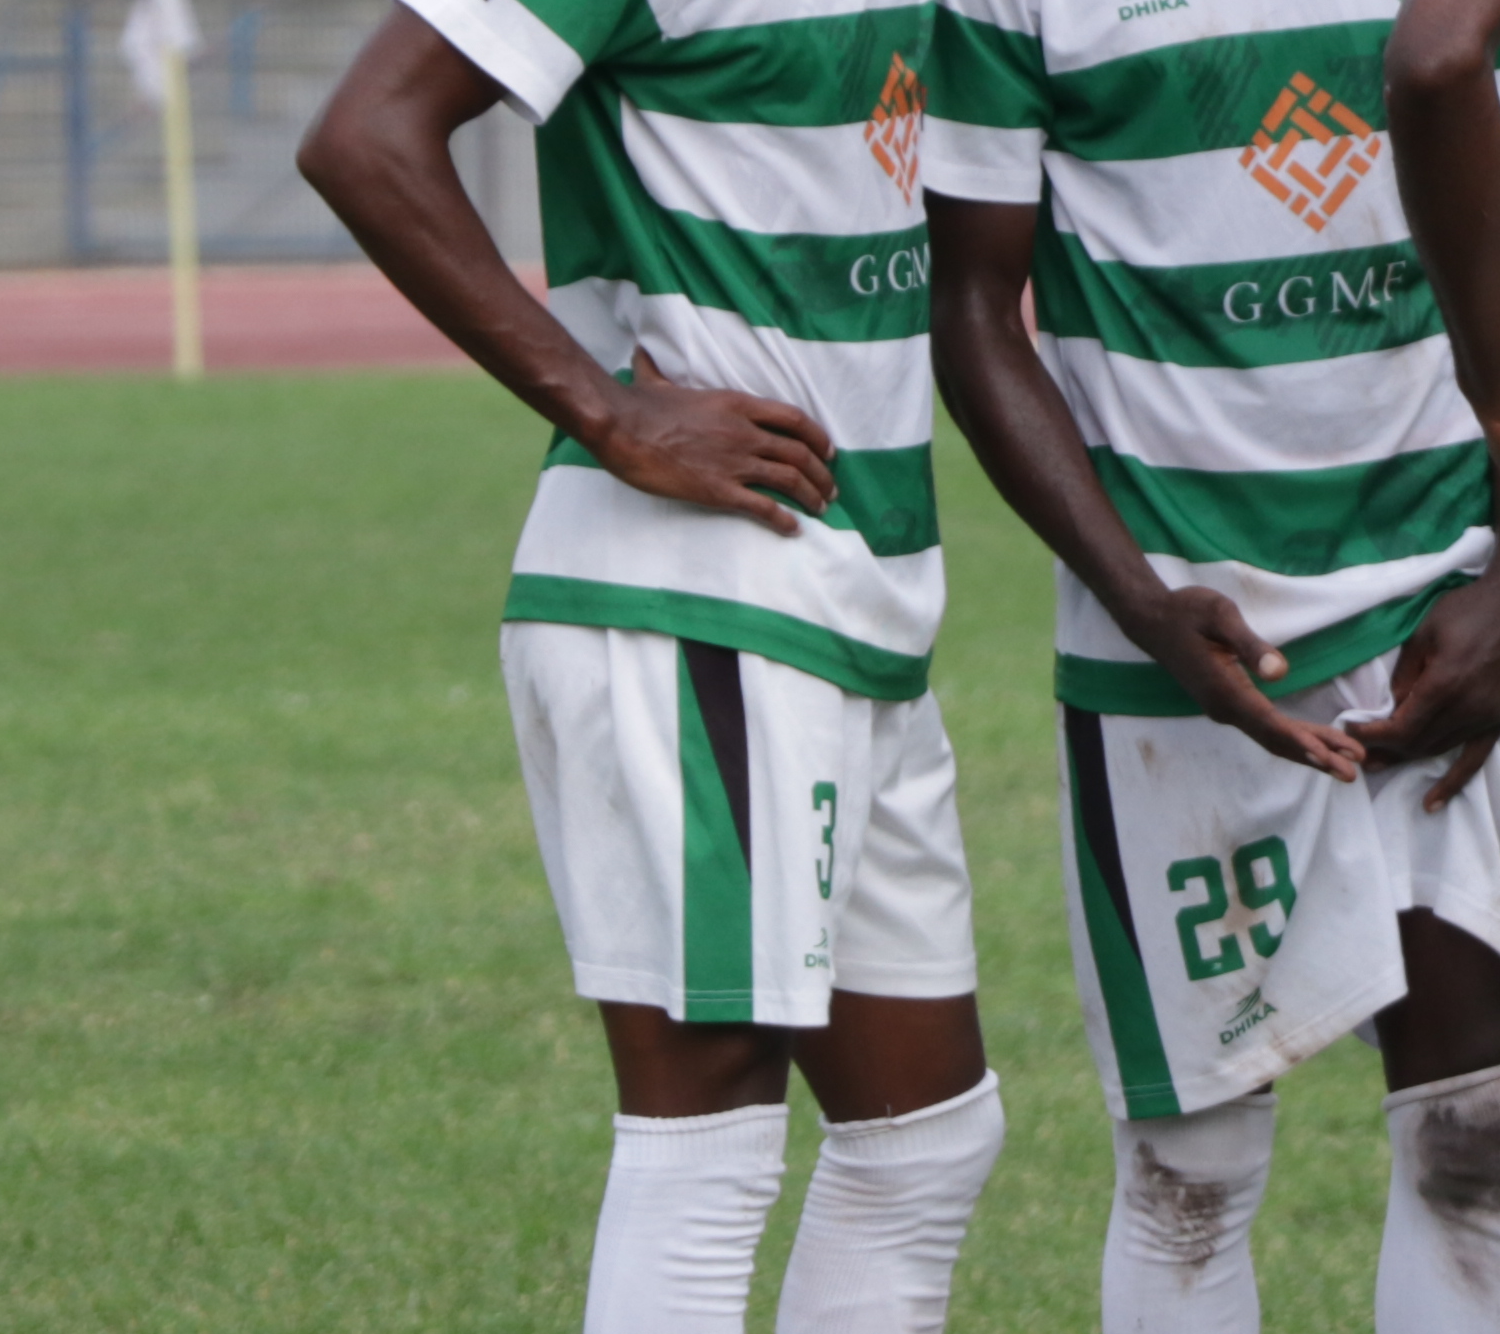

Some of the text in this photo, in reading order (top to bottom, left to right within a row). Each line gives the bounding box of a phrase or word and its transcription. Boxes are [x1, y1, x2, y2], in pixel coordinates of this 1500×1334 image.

[1222, 260, 1407, 323] GGMF
[812, 780, 837, 900] 3
[1166, 834, 1297, 981] 29
[1218, 1002, 1278, 1046] DHIKA
